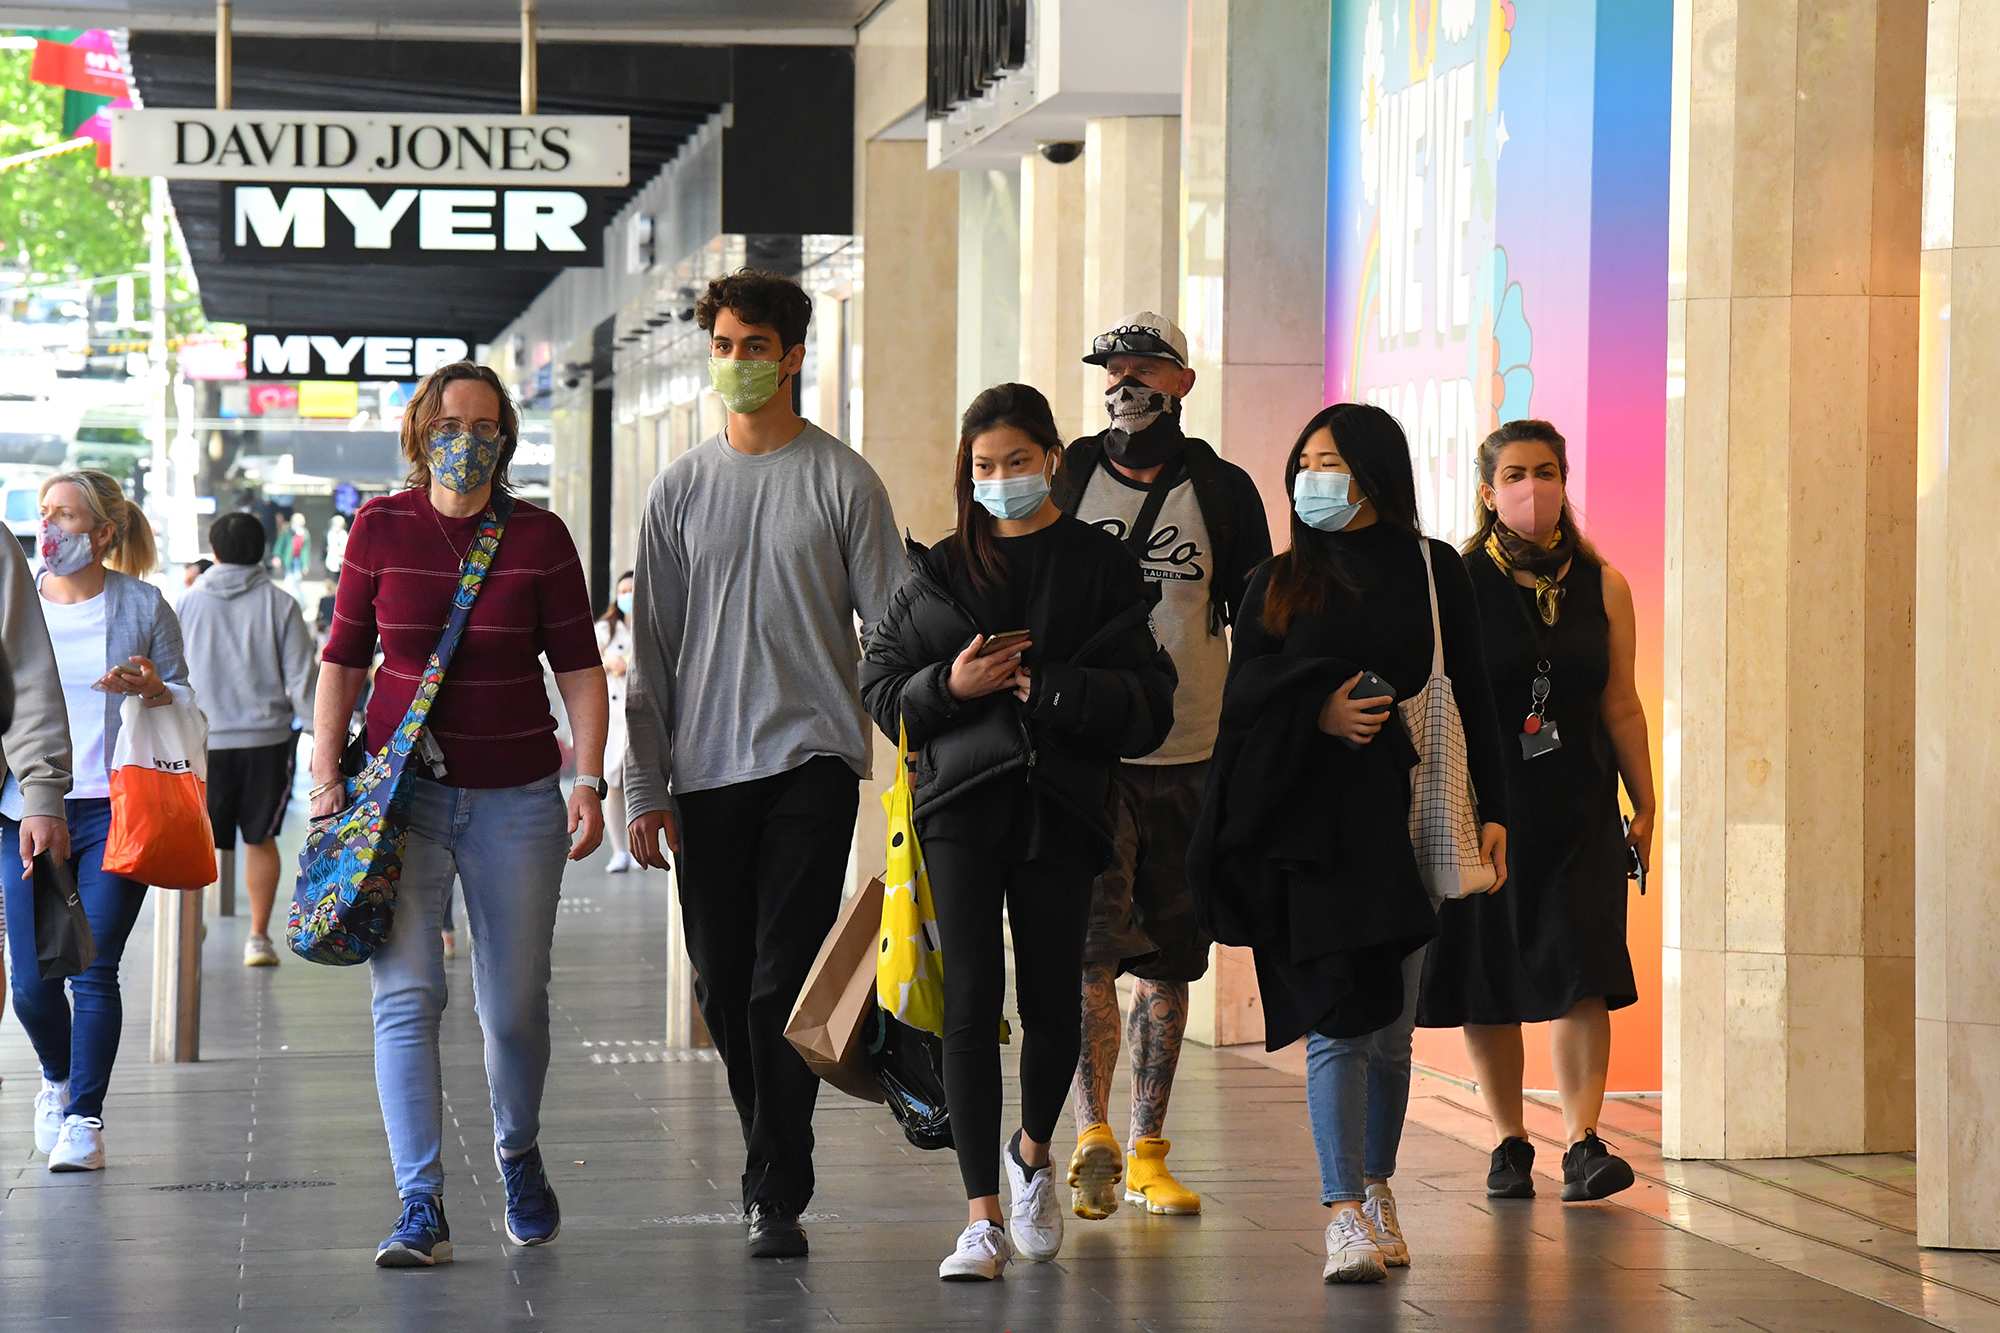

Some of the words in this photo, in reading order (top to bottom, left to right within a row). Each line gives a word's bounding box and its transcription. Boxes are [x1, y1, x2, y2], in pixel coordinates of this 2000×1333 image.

[174, 121, 358, 168] DAVID
[375, 124, 571, 172] JONES
[235, 186, 588, 252] MYER
[1143, 569, 1182, 579] LAUREN
